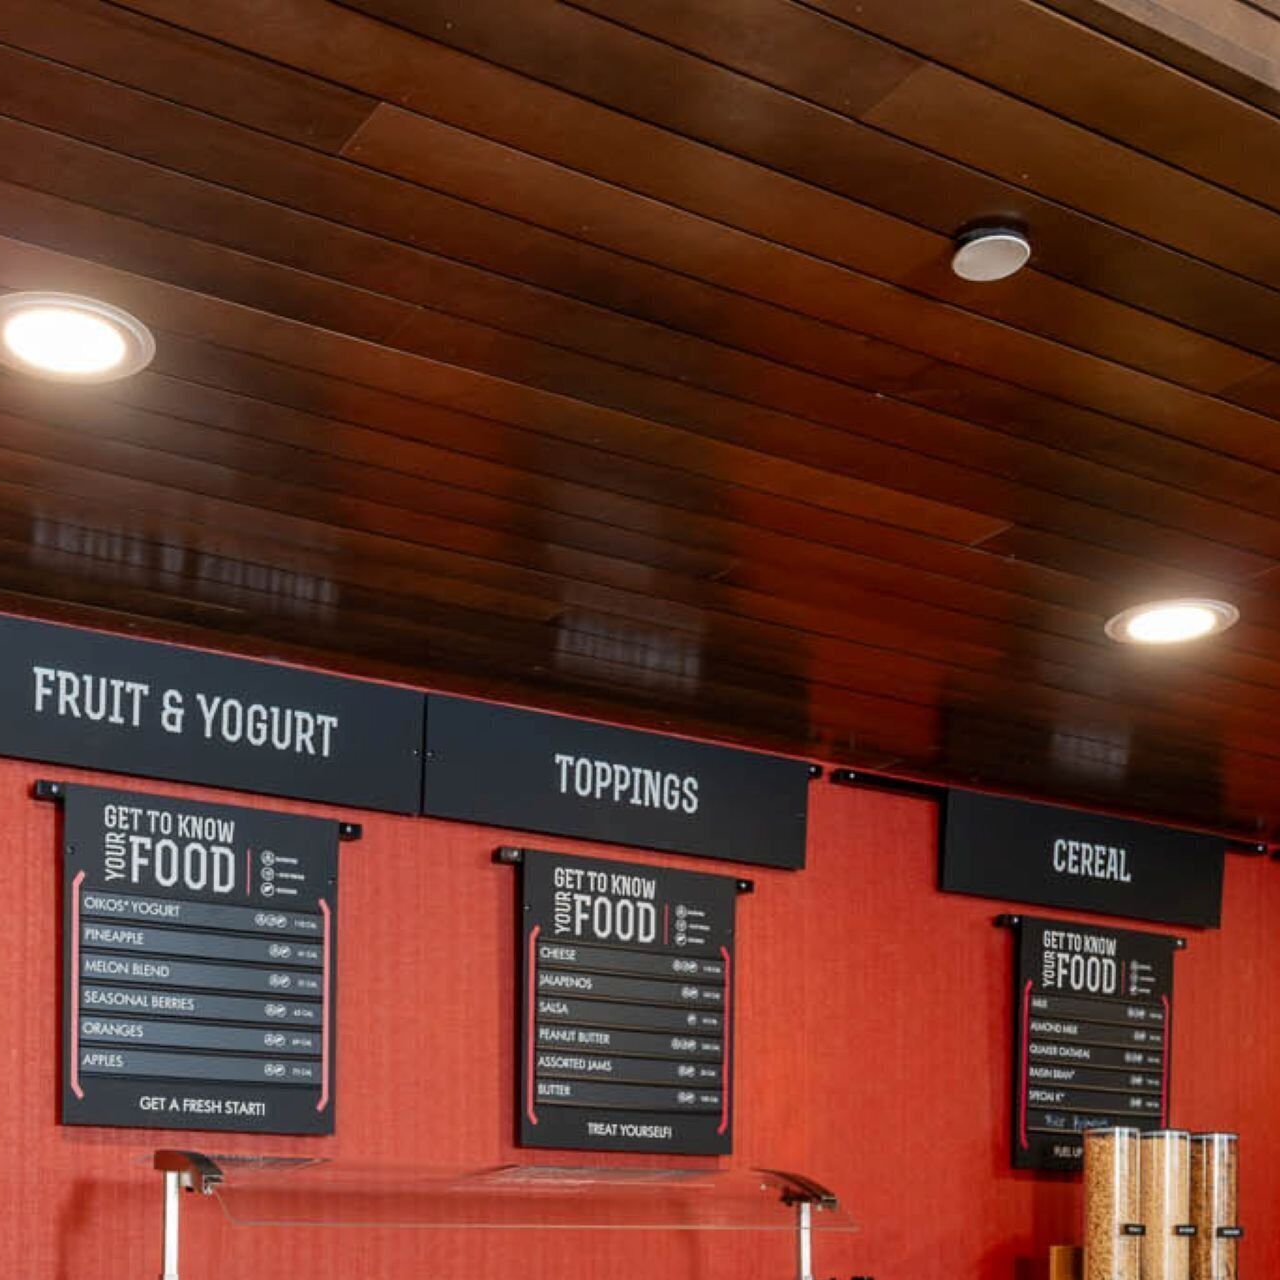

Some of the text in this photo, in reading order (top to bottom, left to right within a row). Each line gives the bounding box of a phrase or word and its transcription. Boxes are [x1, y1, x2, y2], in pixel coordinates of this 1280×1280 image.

[33, 666, 338, 757] FRUIT & YOGURT
[555, 753, 699, 814] TOPPINGS
[104, 804, 235, 844] GET TO KNOW
[104, 831, 126, 881] YOUR
[129, 835, 235, 893] FOOD
[1053, 839, 1132, 882] CEREAL
[554, 867, 656, 900] GET TO KNOW
[131, 900, 180, 917] YOGURT
[554, 891, 571, 935] YOUR
[573, 893, 656, 943] FOOD
[84, 928, 144, 945] PINEAPPLE
[1043, 930, 1117, 956] GET TO KNOW
[540, 947, 576, 961] CHEESE
[84, 959, 170, 977] MELON BLEND
[1042, 950, 1055, 988] YOUR
[1057, 953, 1117, 994] FOOD
[84, 990, 195, 1011] SEASONAL BERRIES
[539, 1002, 568, 1015] SALSA
[82, 1022, 144, 1037] ORANGES
[539, 1027, 610, 1045] PEANUT BUTTER
[82, 1053, 124, 1067] APPLES
[538, 1056, 586, 1071] ASSORTED
[538, 1084, 570, 1096] BUTTER
[140, 1096, 166, 1110] GET
[168, 1098, 180, 1112] A
[183, 1099, 222, 1114] FRESH
[588, 1122, 618, 1137] TREAT
